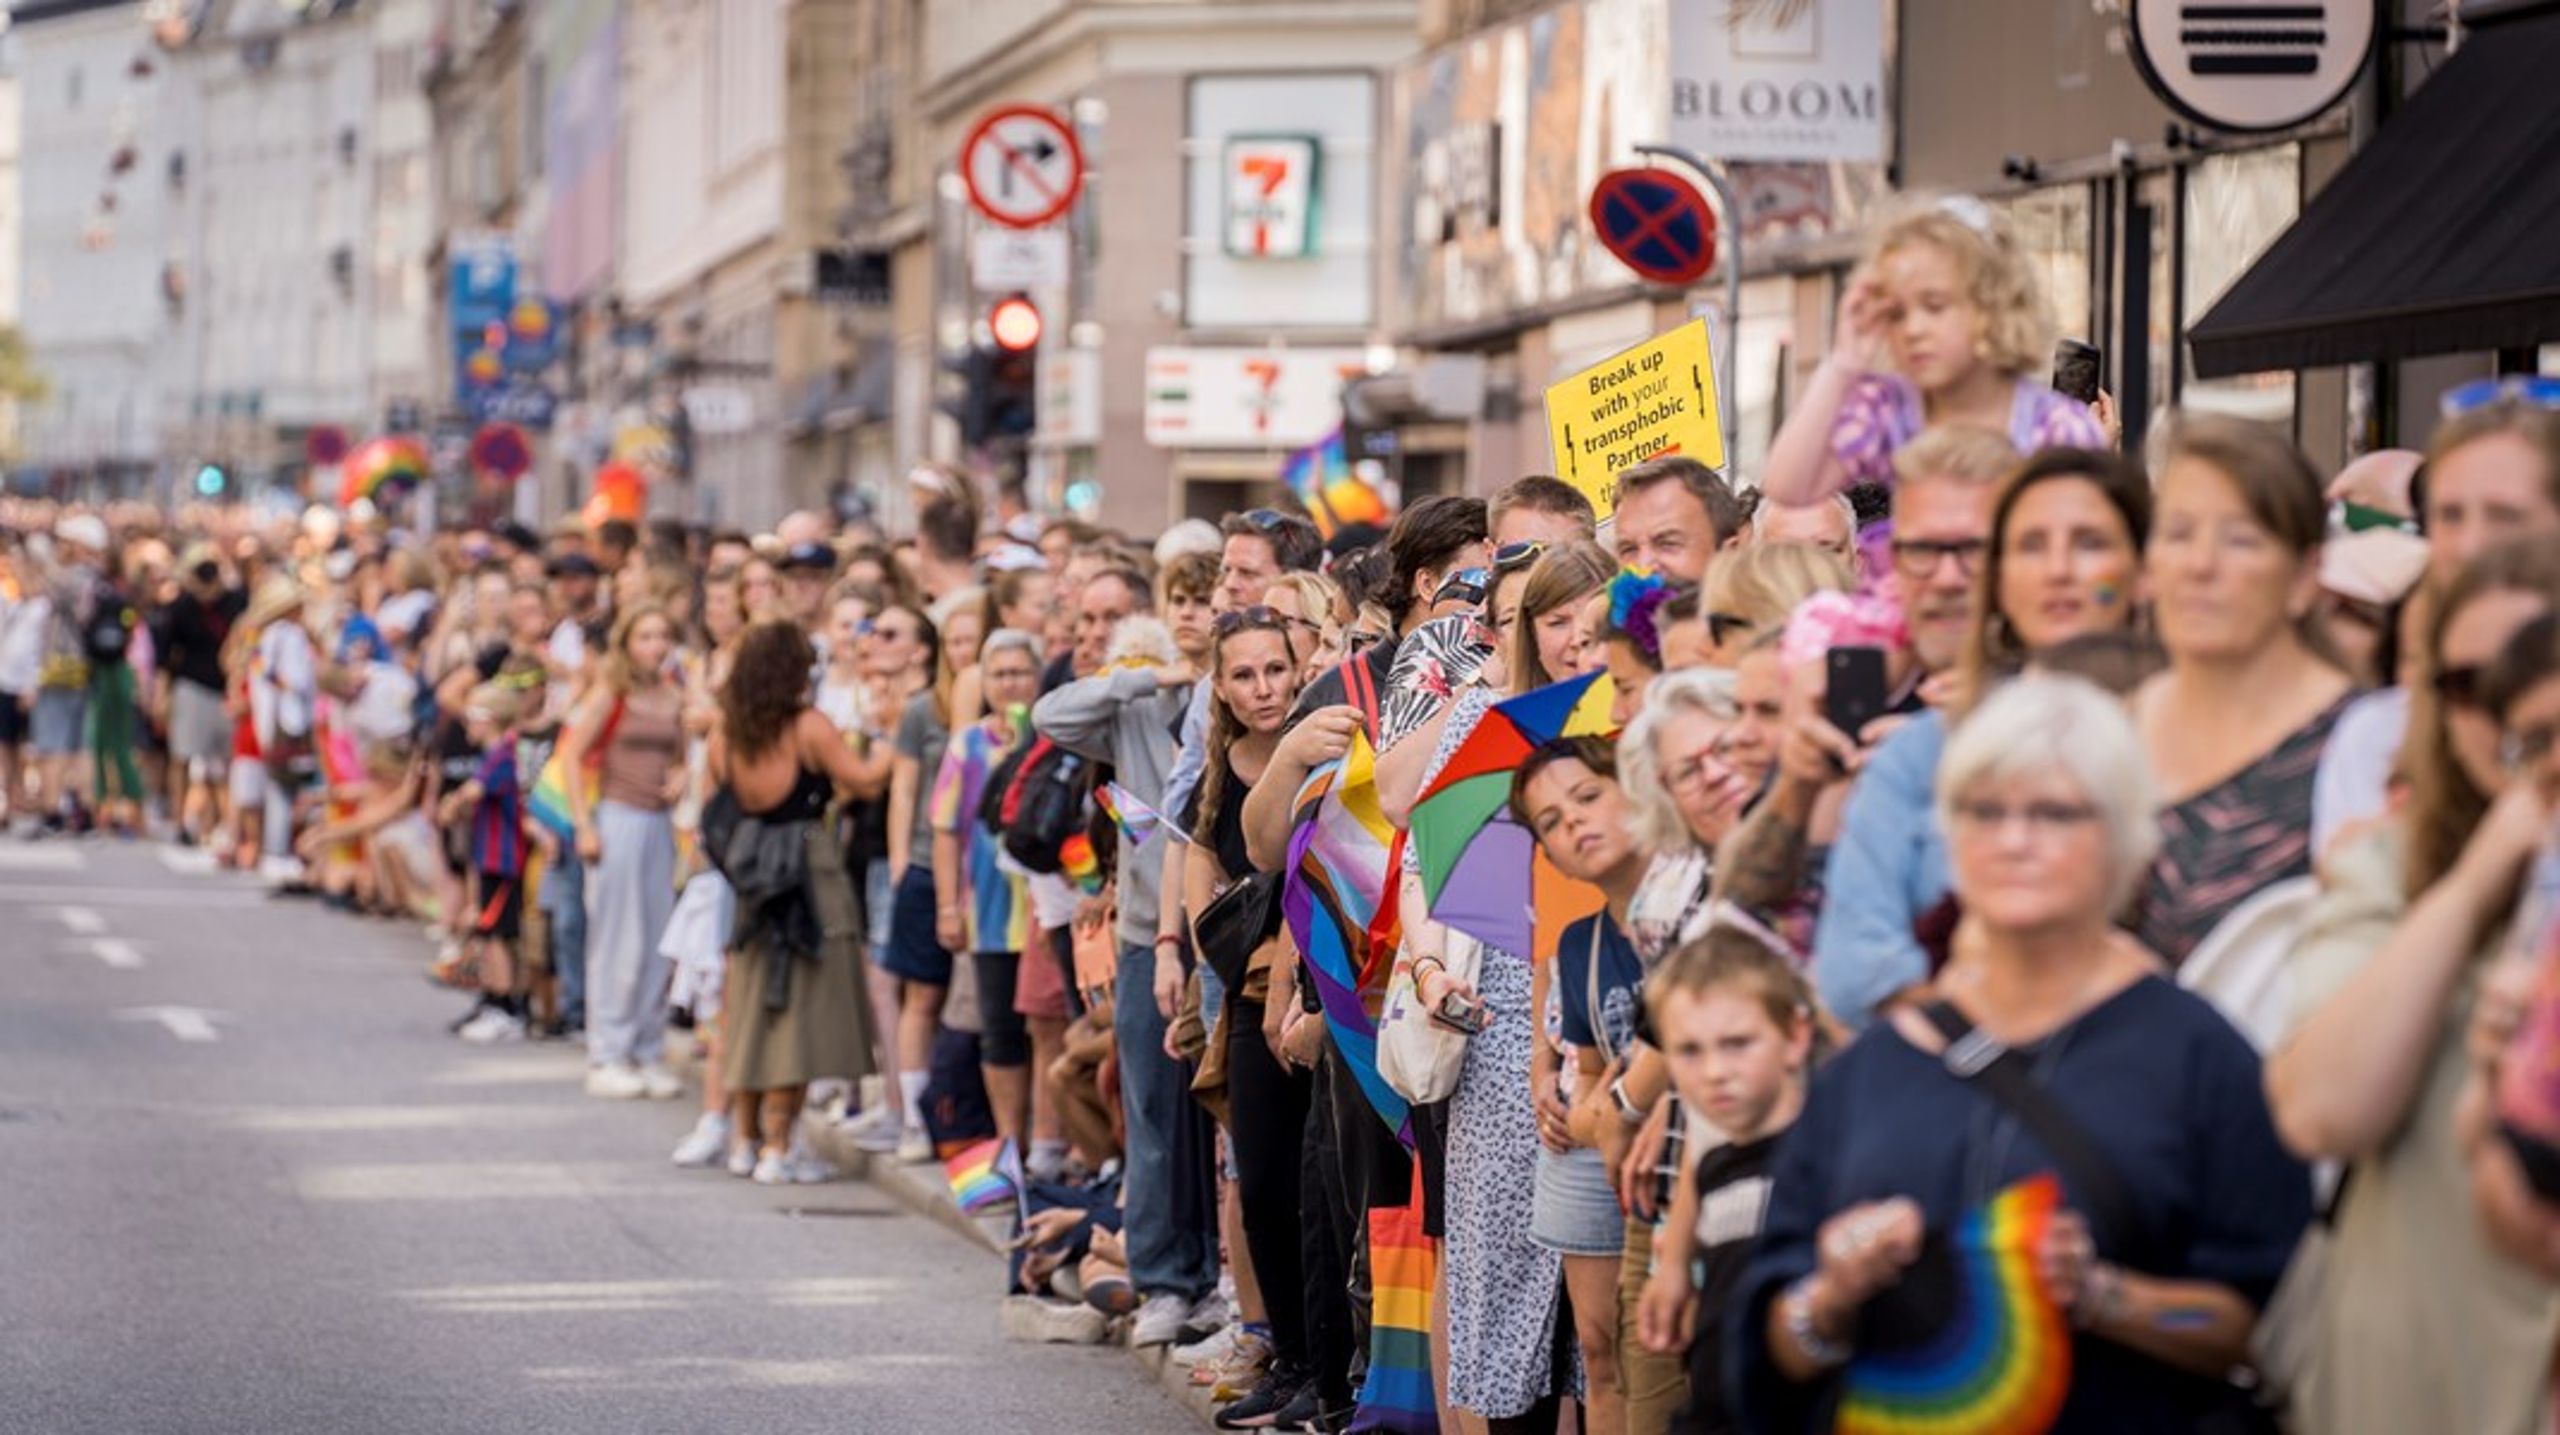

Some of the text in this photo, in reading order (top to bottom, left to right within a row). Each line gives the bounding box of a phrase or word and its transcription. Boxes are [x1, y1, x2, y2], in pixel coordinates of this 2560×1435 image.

[1671, 78, 1876, 121] BLOOM
[1589, 350, 1664, 396] Break up
[1591, 375, 1669, 422] with your
[1584, 397, 1685, 454] transphobic
[1607, 432, 1669, 472] Partner
